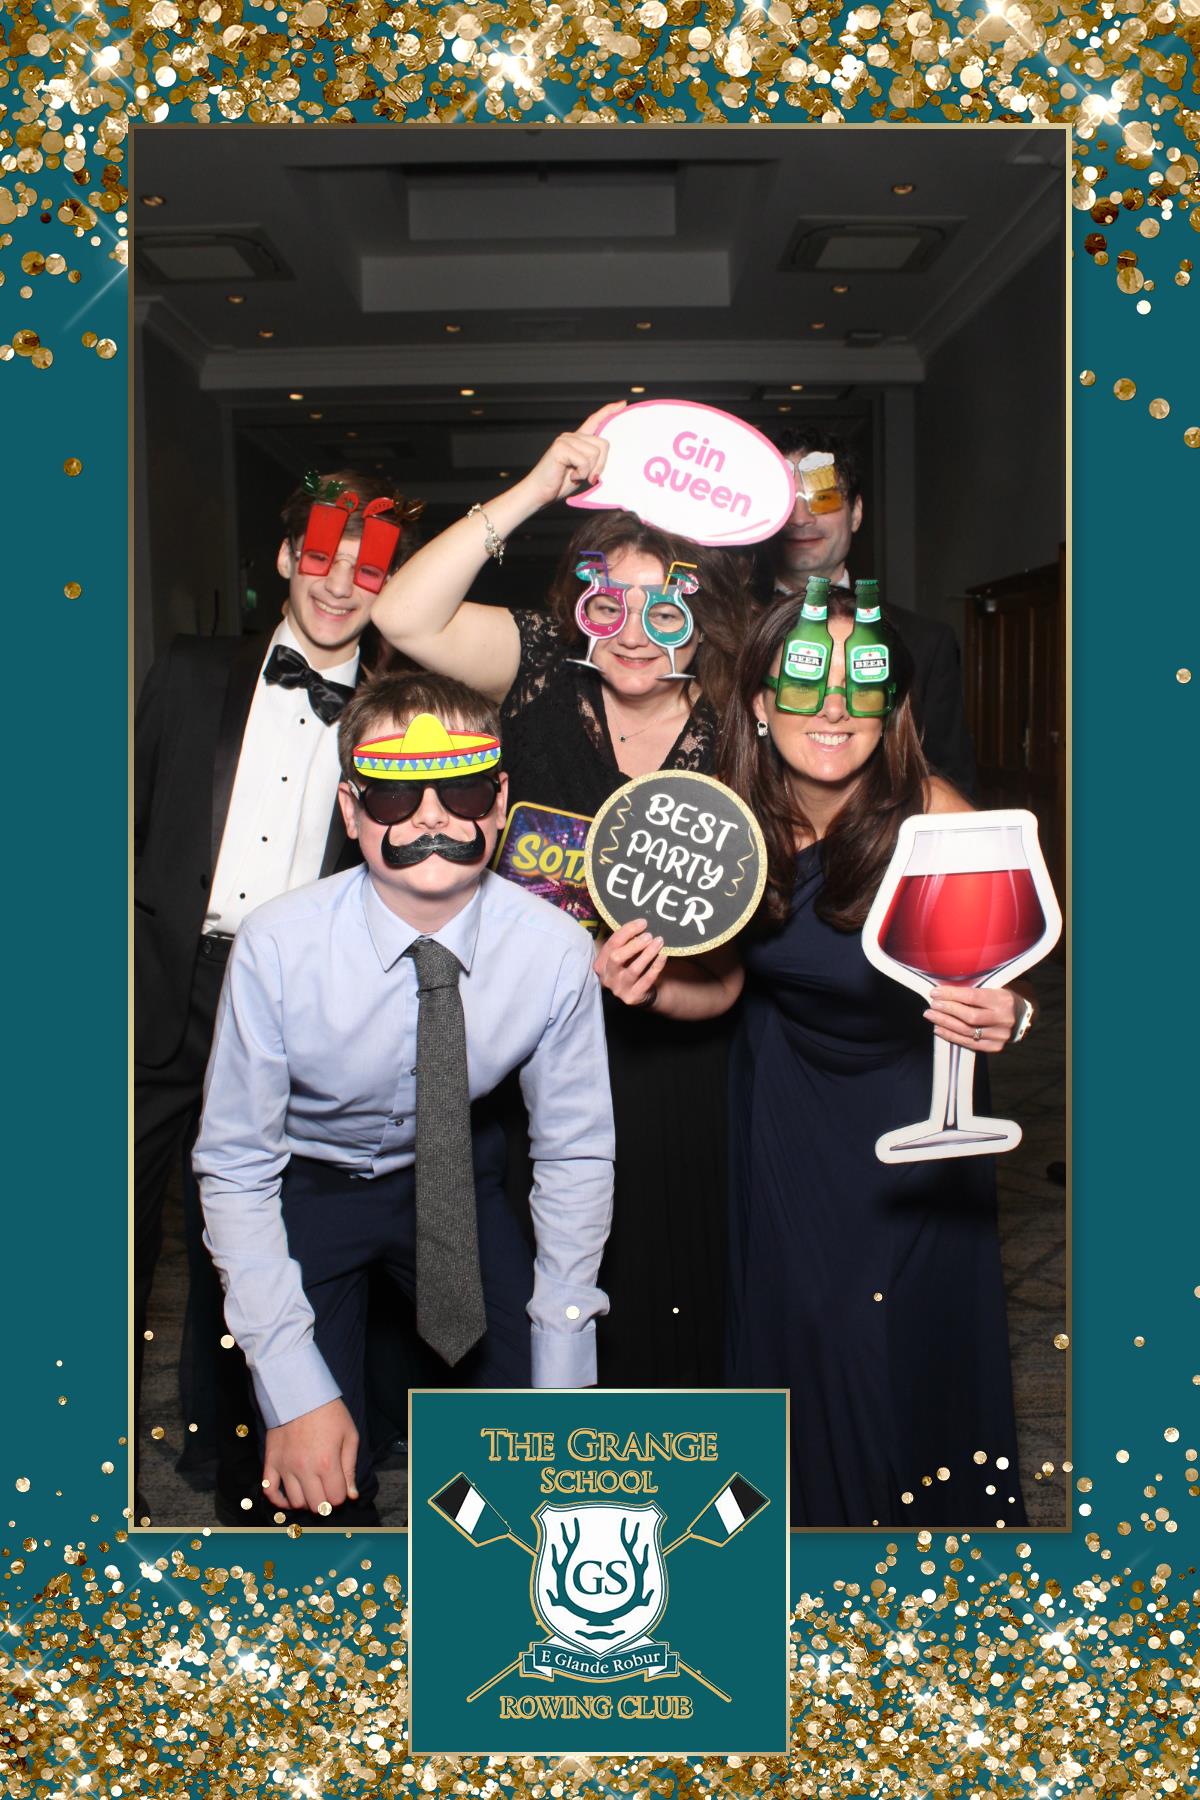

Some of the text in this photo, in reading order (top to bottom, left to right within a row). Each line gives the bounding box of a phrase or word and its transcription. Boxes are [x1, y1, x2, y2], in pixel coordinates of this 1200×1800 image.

[673, 431, 726, 472] Gin
[643, 456, 752, 517] Queen
[790, 655, 820, 666] BEER
[855, 659, 884, 668] BEER
[645, 793, 738, 851] BEST
[626, 830, 724, 890] PARTY
[606, 863, 714, 935] EVER
